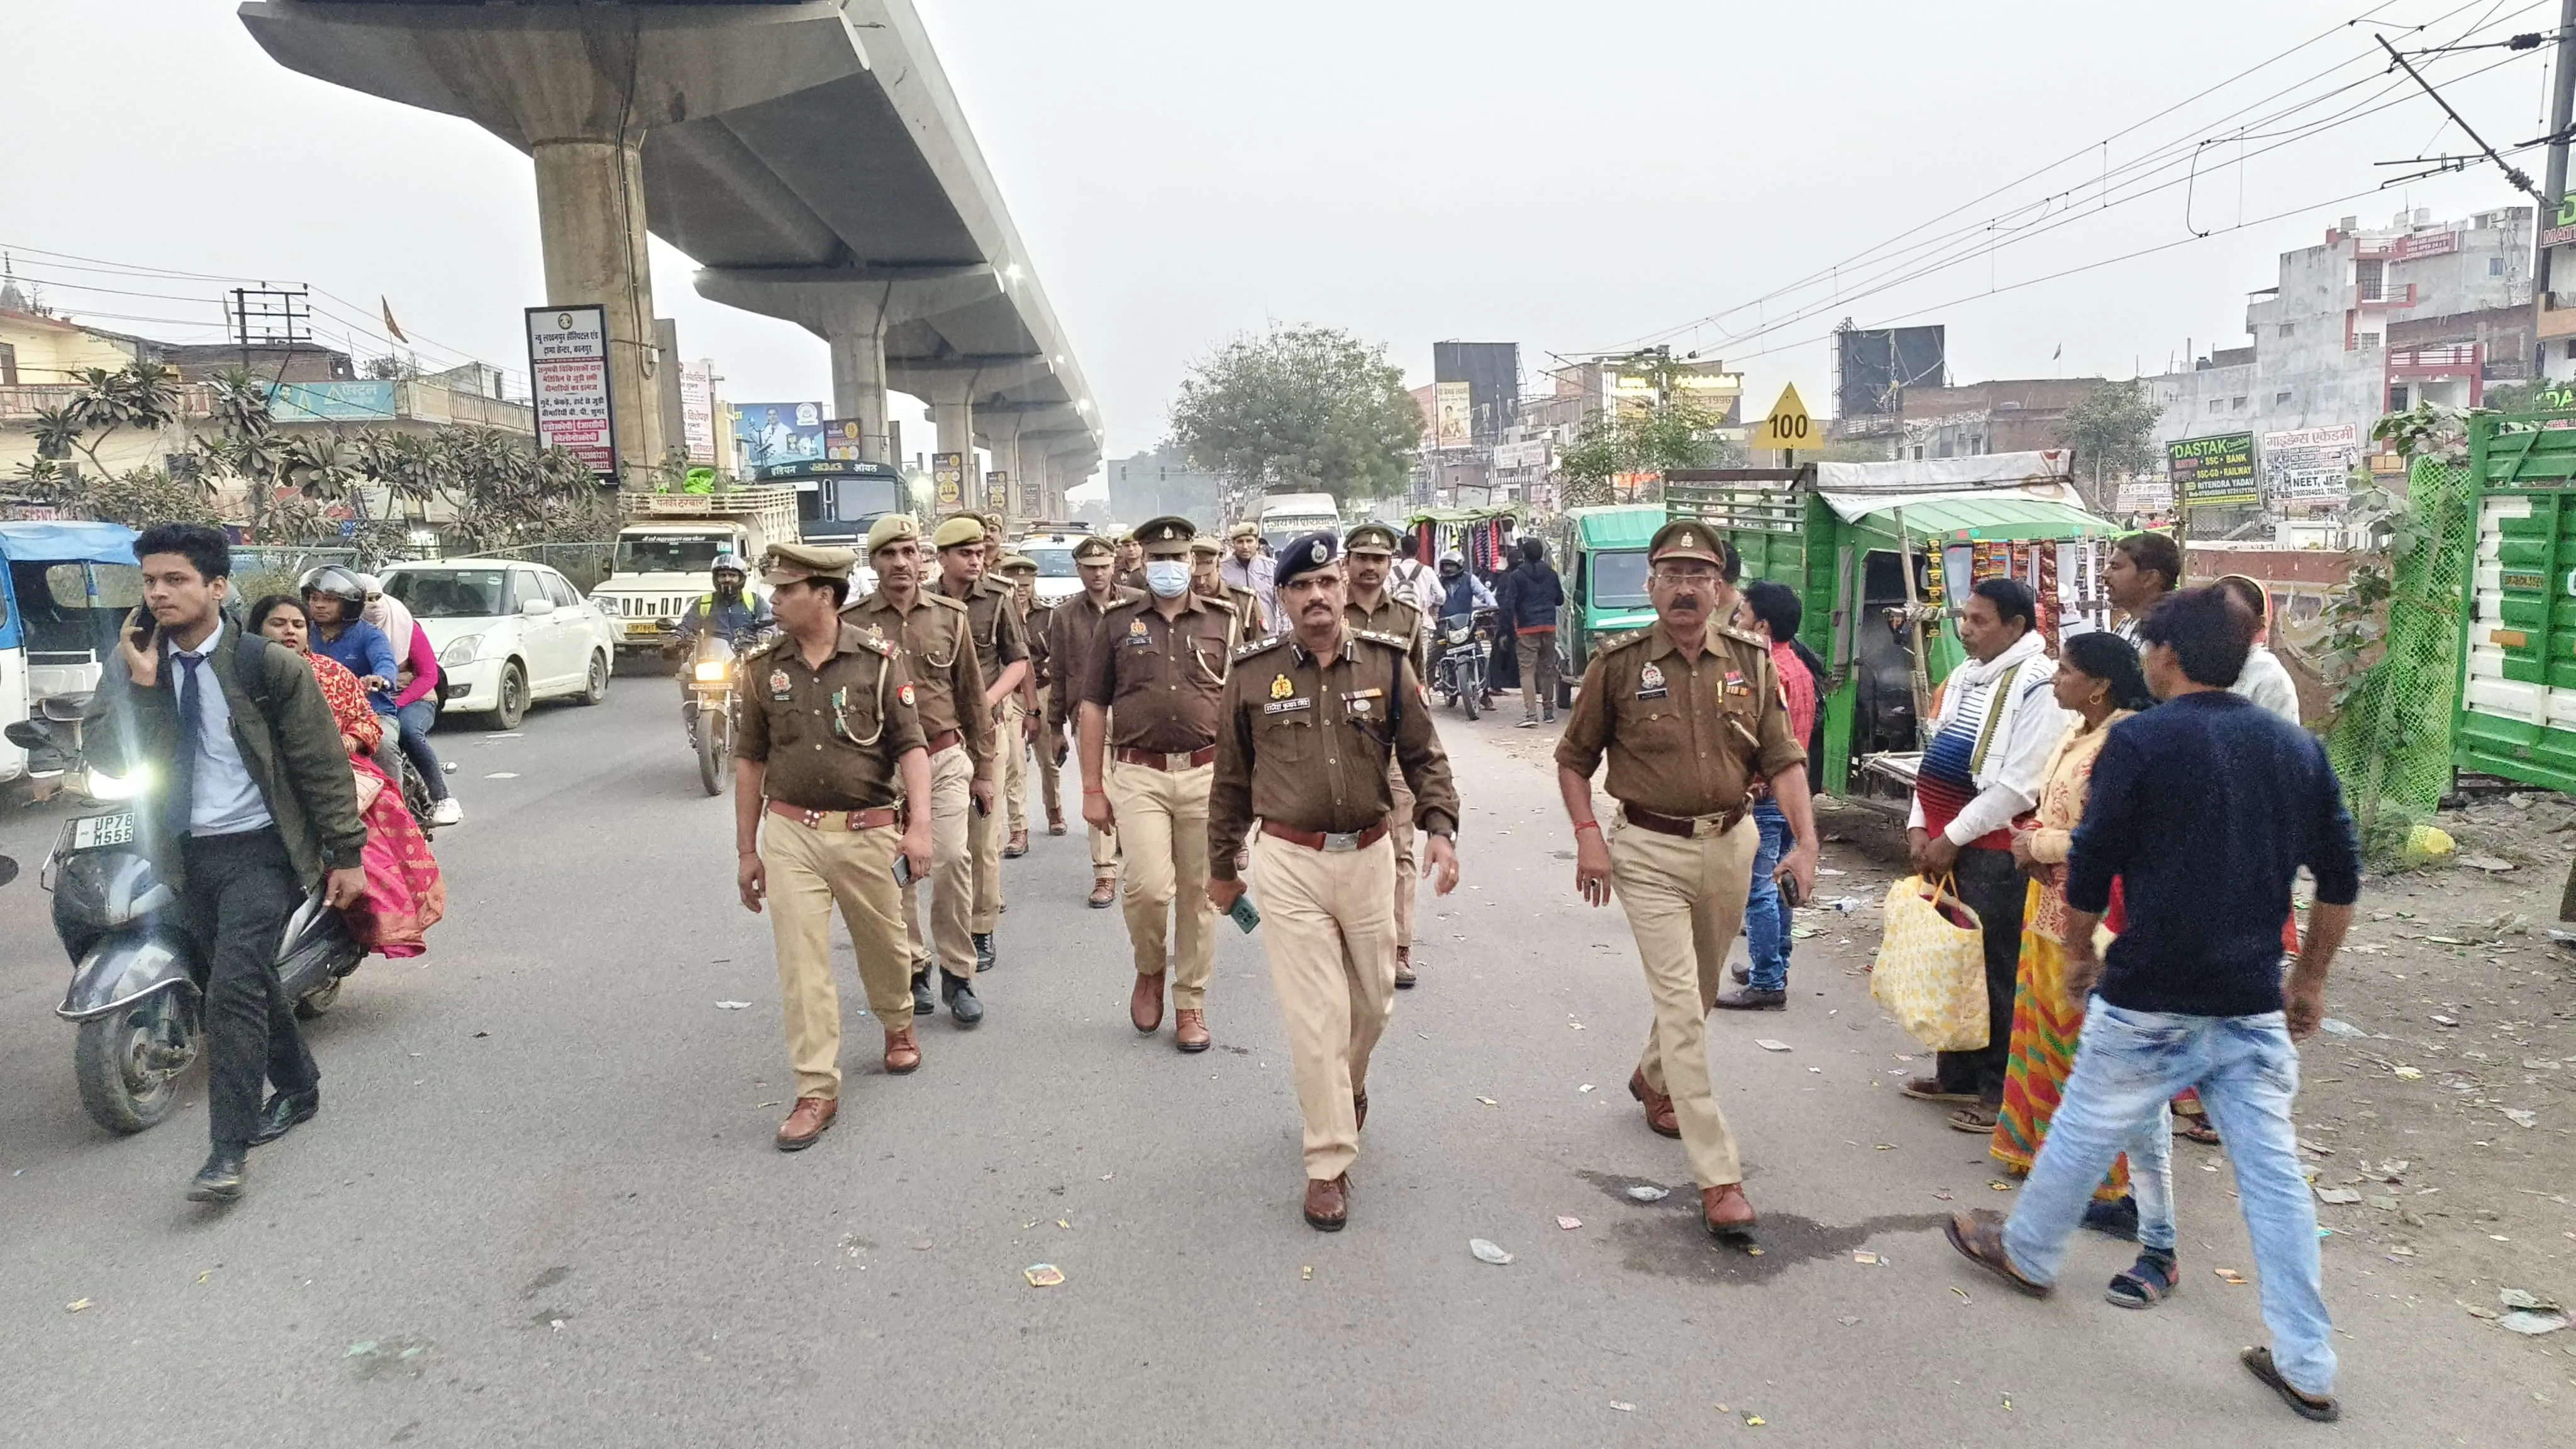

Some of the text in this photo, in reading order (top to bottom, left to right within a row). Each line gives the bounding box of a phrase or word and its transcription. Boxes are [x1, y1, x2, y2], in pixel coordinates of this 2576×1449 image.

[1769, 414, 1807, 438] 100
[2174, 439, 2228, 458] DASTAK
[2205, 456, 2219, 465] SSC
[2226, 453, 2246, 463] BANK
[2223, 465, 2251, 476] RAILWAY
[2197, 477, 2255, 490] RITENDRA YADAV
[2293, 476, 2321, 487] NEET,
[95, 814, 133, 831] UP78
